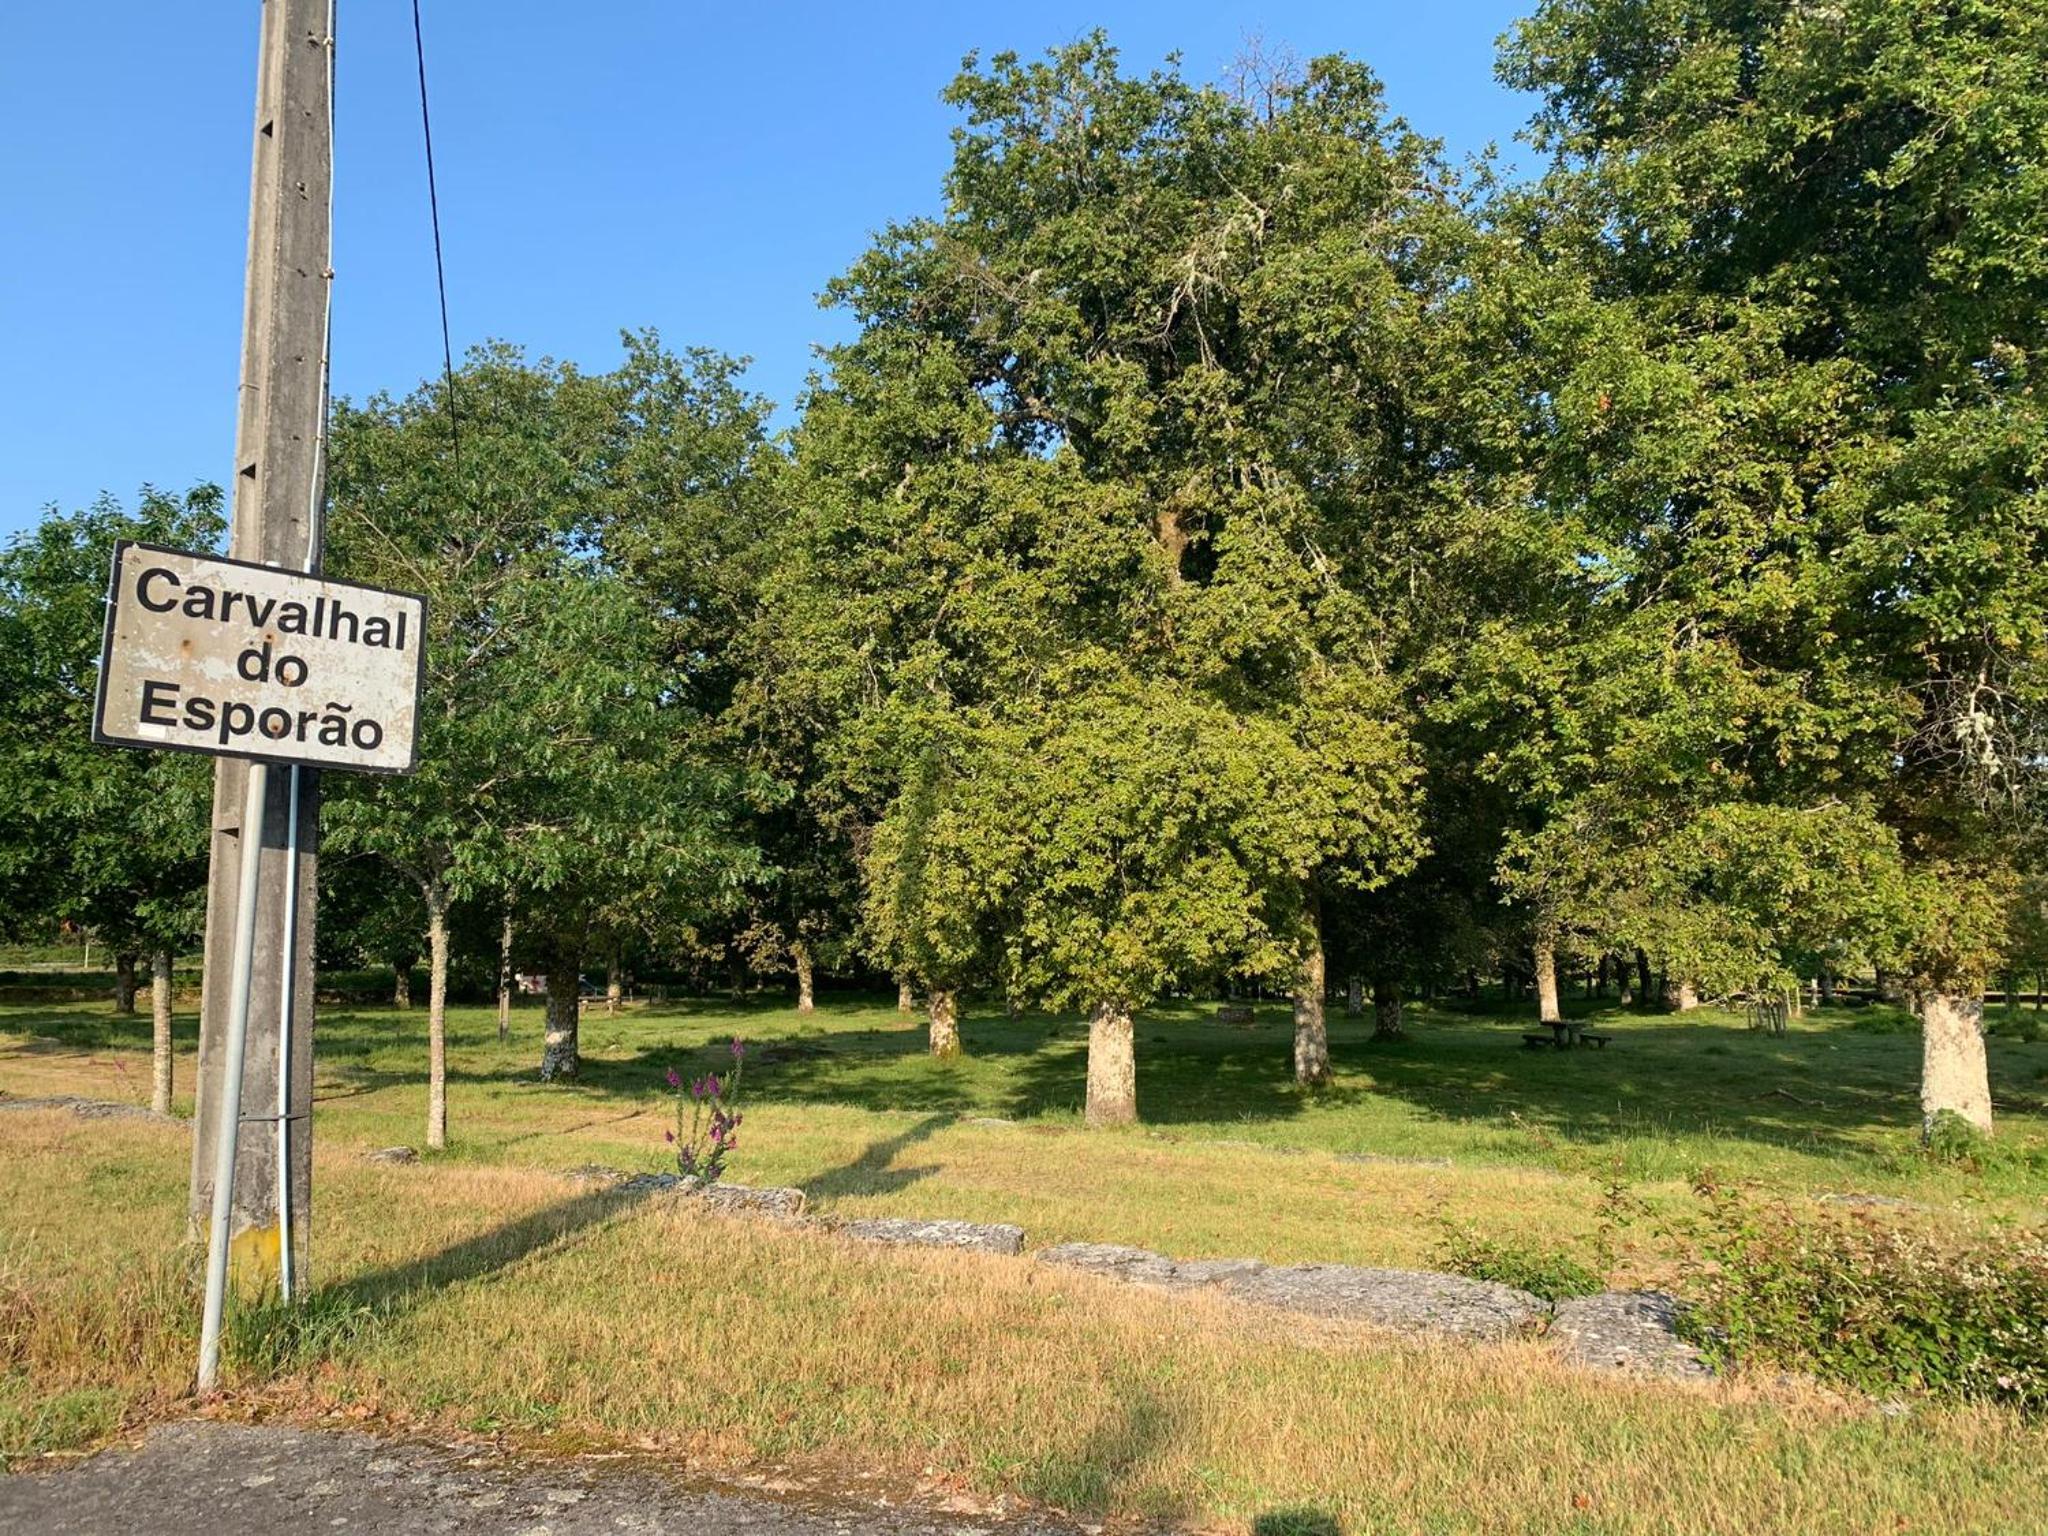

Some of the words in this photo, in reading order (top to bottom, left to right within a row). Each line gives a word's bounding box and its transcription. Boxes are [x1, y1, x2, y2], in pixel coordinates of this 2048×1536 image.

[136, 568, 407, 651] Carvalhal
[237, 641, 308, 687] do
[140, 680, 383, 750] Esporão
